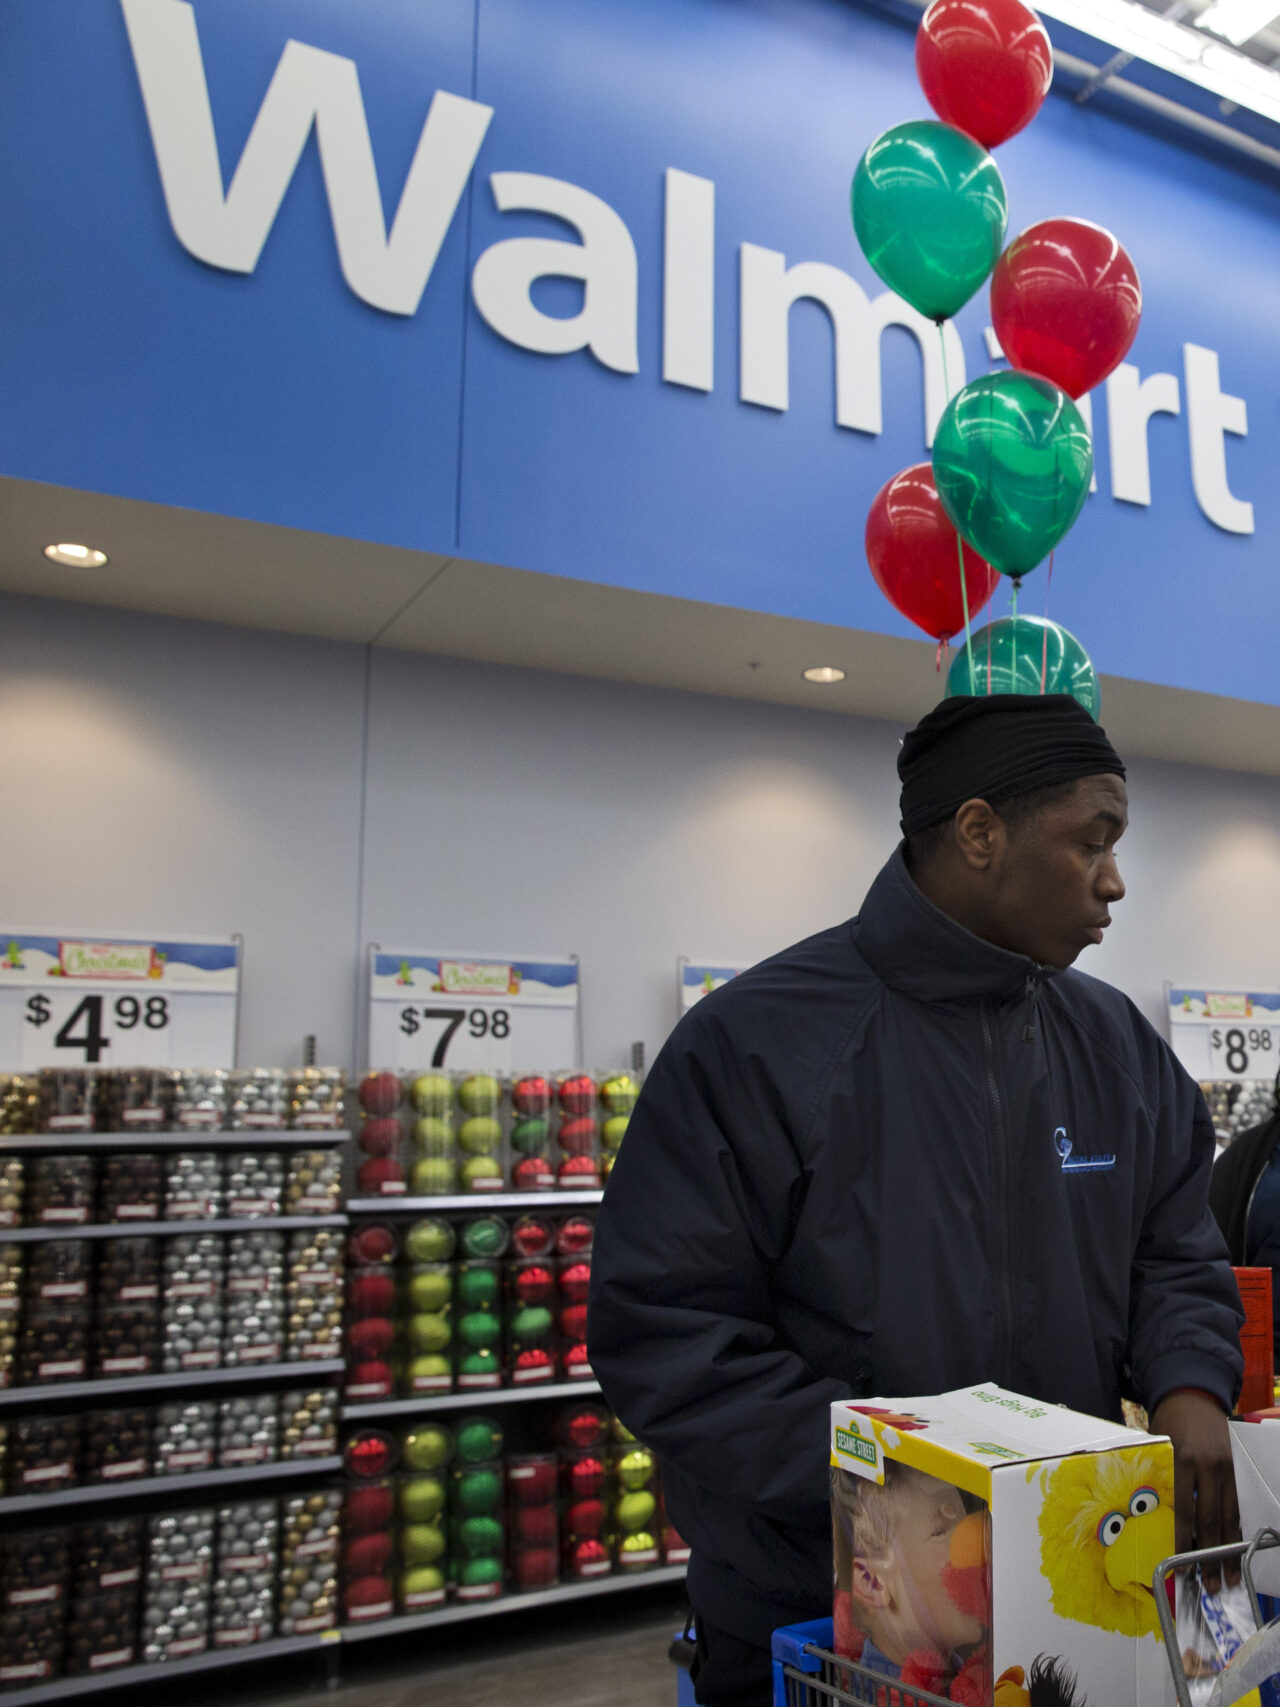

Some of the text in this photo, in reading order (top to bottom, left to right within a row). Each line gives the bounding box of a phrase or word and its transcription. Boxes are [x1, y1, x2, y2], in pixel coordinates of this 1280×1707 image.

[120, 0, 1255, 535] Walmrt
[837, 1431, 875, 1463] SESAME STREET
